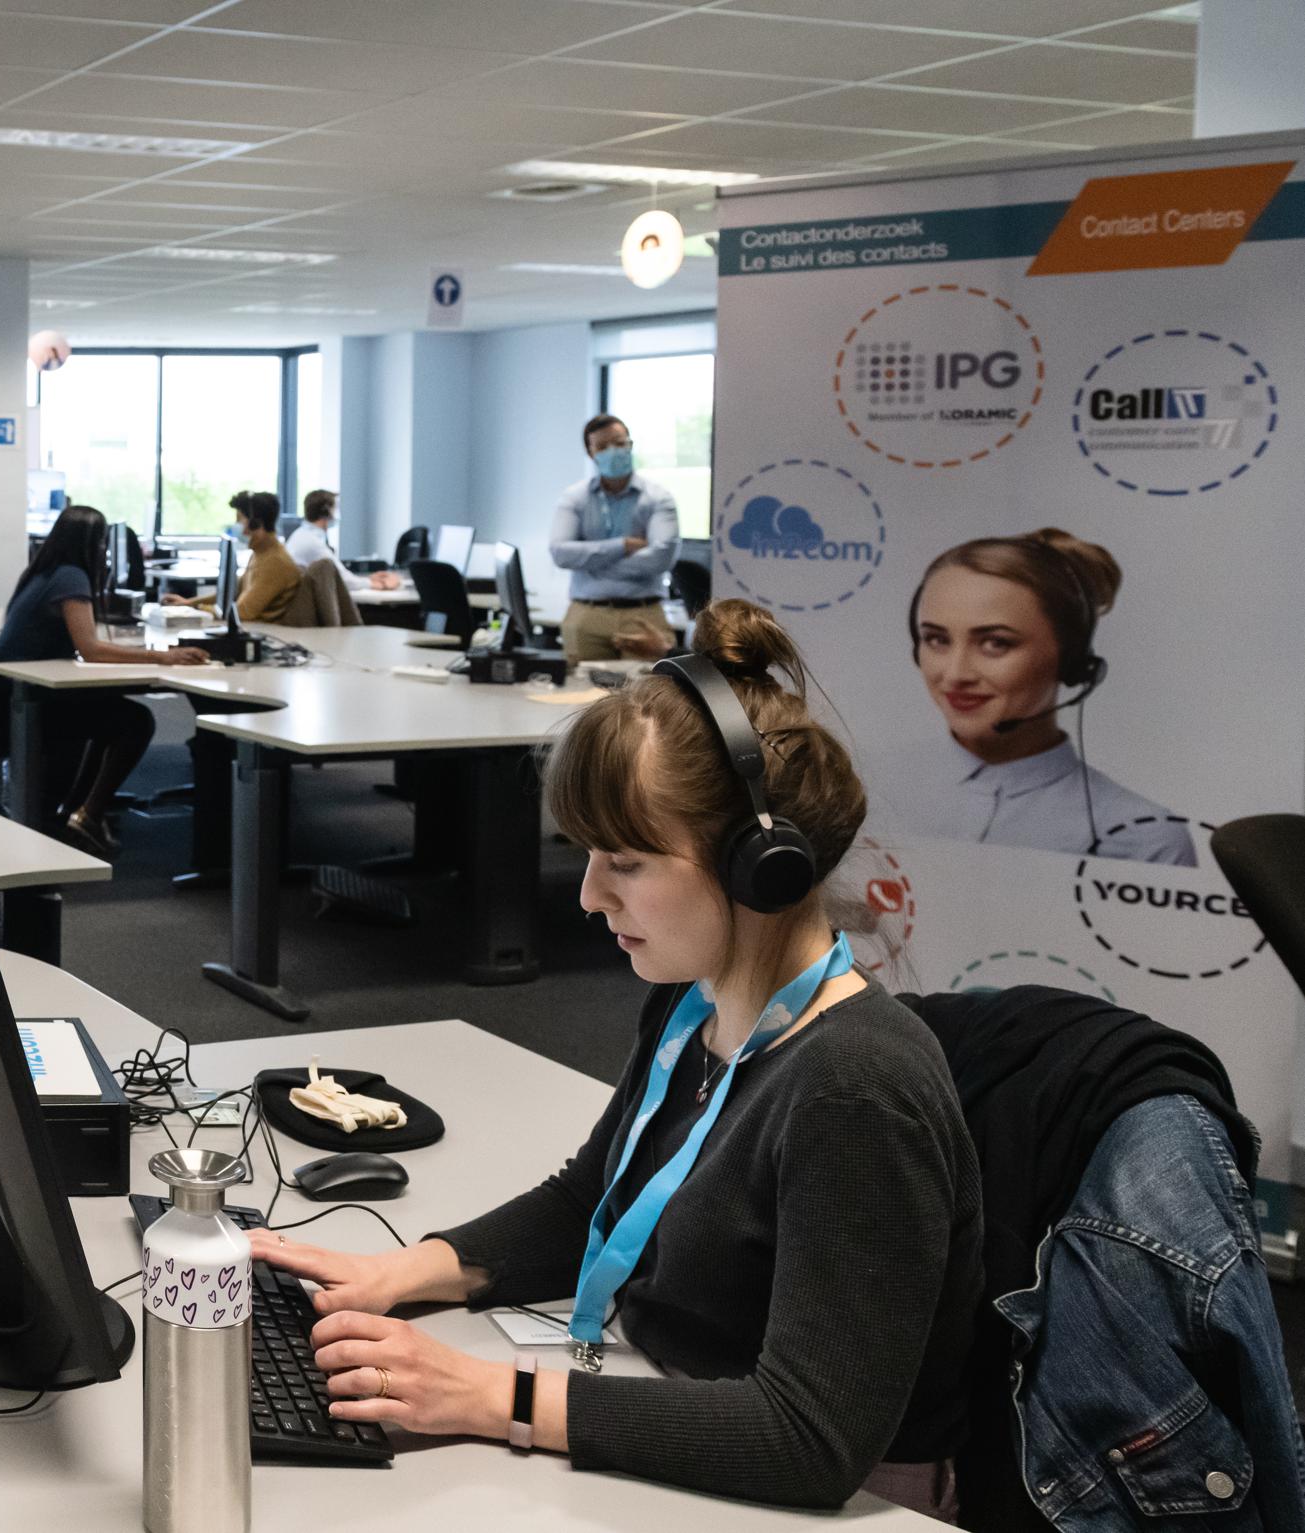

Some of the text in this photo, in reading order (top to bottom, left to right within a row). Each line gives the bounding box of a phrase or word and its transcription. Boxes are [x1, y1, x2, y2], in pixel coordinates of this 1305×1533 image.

[740, 218, 924, 249] Contactonderzoek
[1080, 208, 1246, 239] Contact Centers
[740, 242, 948, 272] Le suivi des contacts
[935, 351, 1022, 390] IPG
